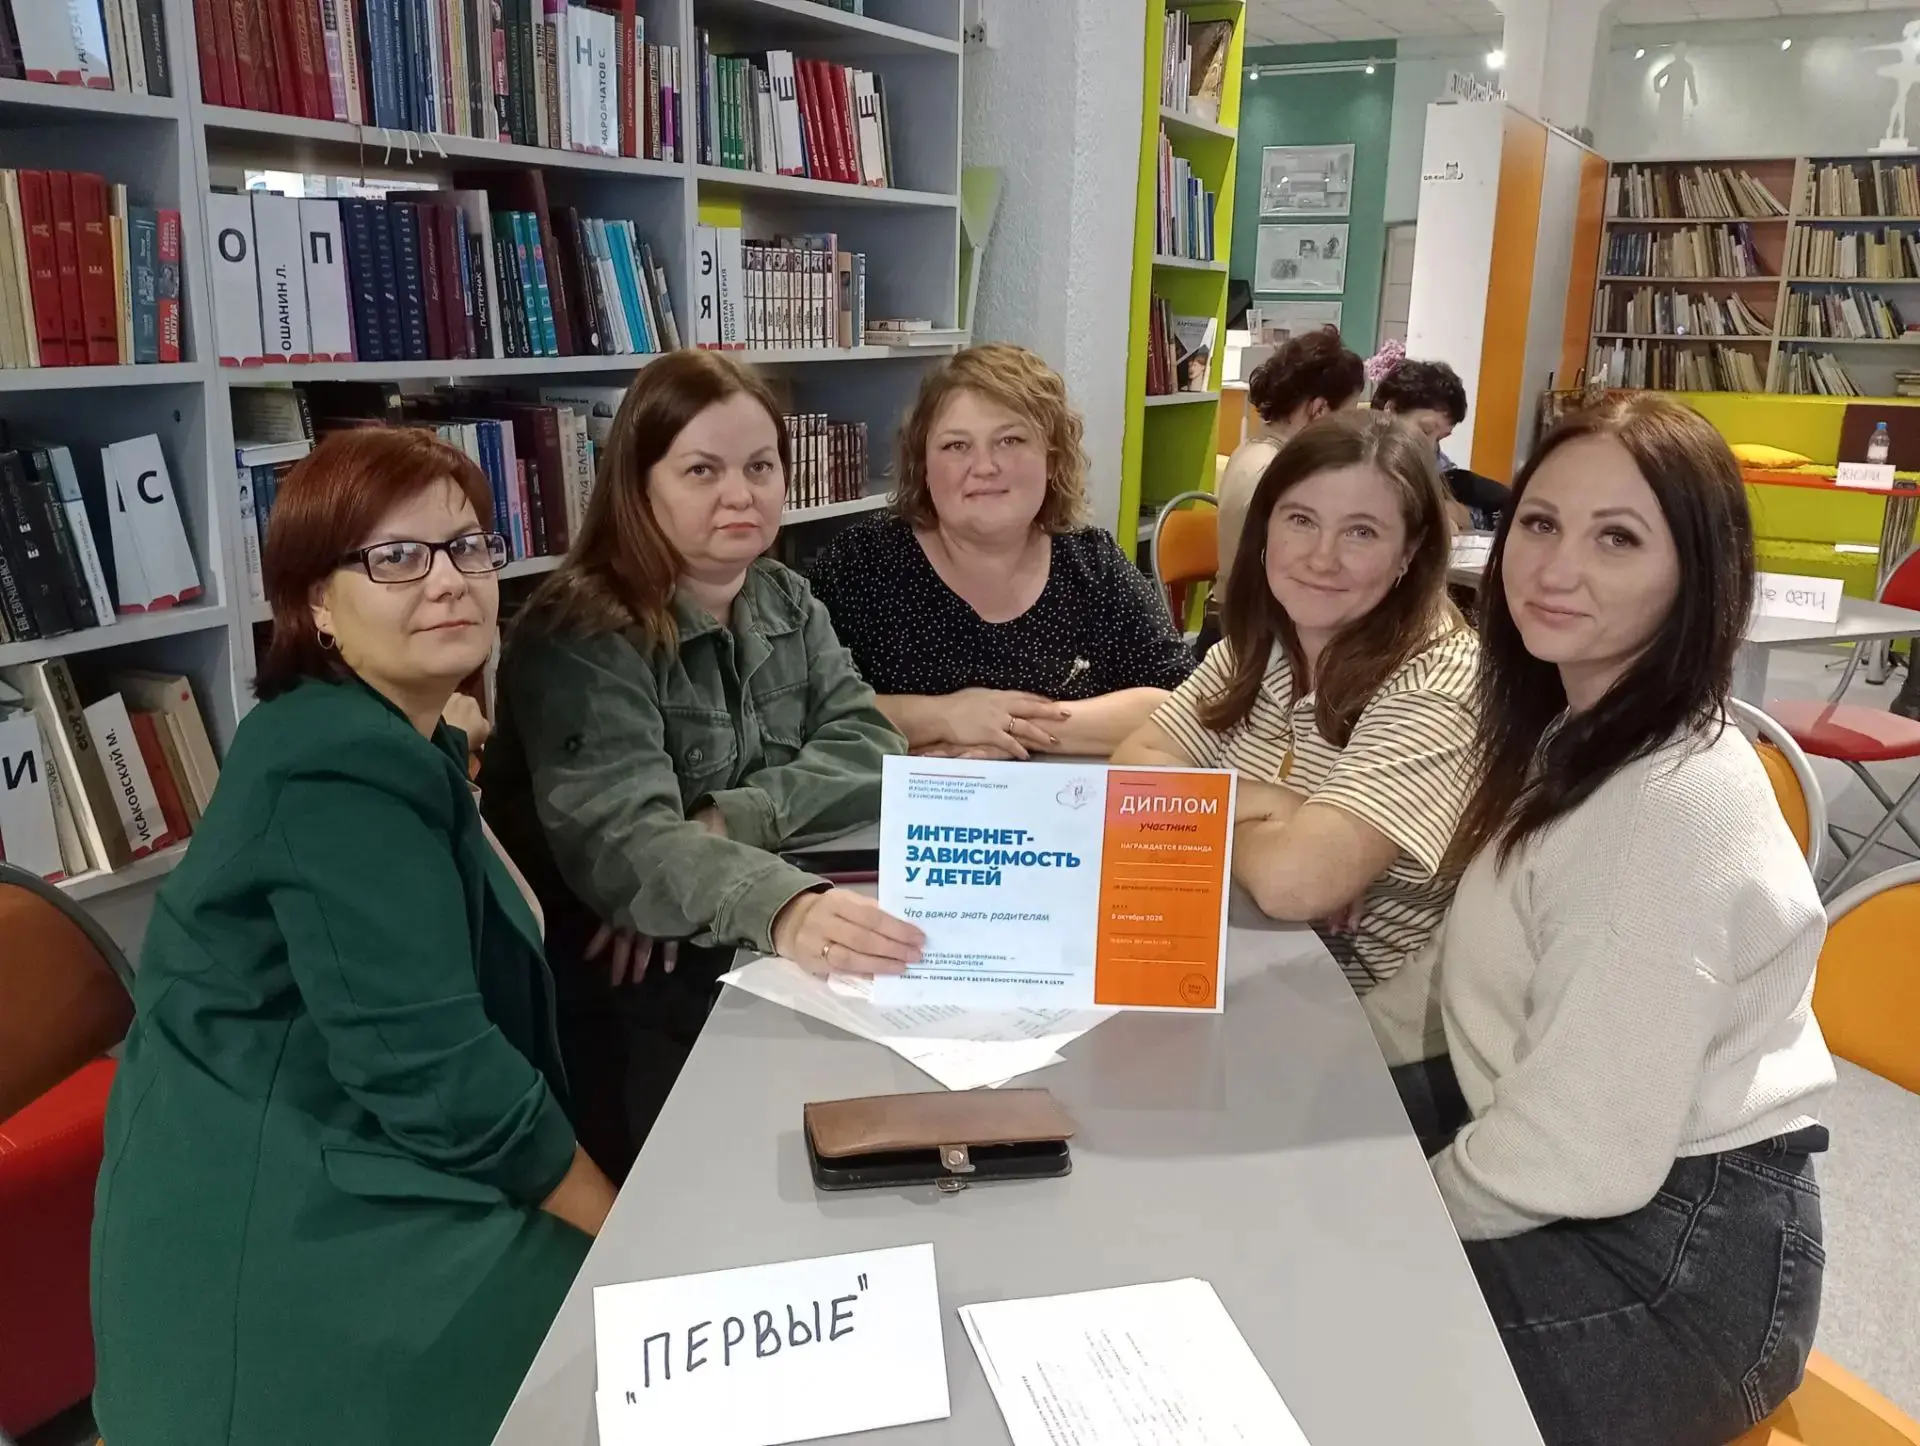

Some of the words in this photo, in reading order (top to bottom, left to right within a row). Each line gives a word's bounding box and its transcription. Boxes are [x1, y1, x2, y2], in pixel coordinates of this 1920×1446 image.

[576, 36, 592, 66] Н
[776, 76, 794, 101] Ш
[858, 94, 877, 122] Щ
[218, 228, 246, 262] О
[310, 232, 333, 264] П
[276, 263, 288, 280] Л.
[701, 250, 712, 276] Э
[476, 271, 487, 327] ПАСТЕРНАК
[700, 296, 711, 320] Я
[278, 284, 292, 351] ОШАНИН
[137, 470, 164, 504] С
[106, 728, 118, 747] М.
[2, 750, 38, 790] И
[108, 748, 152, 841] ИСАКОВСКИЙ
[1120, 796, 1218, 814] ДИПЛОМ
[907, 824, 1034, 845] ИНТЕРНЕТ-
[1139, 822, 1198, 832] участника
[906, 845, 1081, 868] ЗАВИСИМОСТЬ
[1120, 843, 1176, 851] НАГРАЖДАЕТСЯ
[905, 866, 921, 882] У
[925, 866, 1002, 886] ДЕТЕЙ
[904, 907, 922, 918] Что
[925, 910, 958, 919] важно
[961, 912, 988, 920] знать
[991, 912, 1050, 924] родителям
